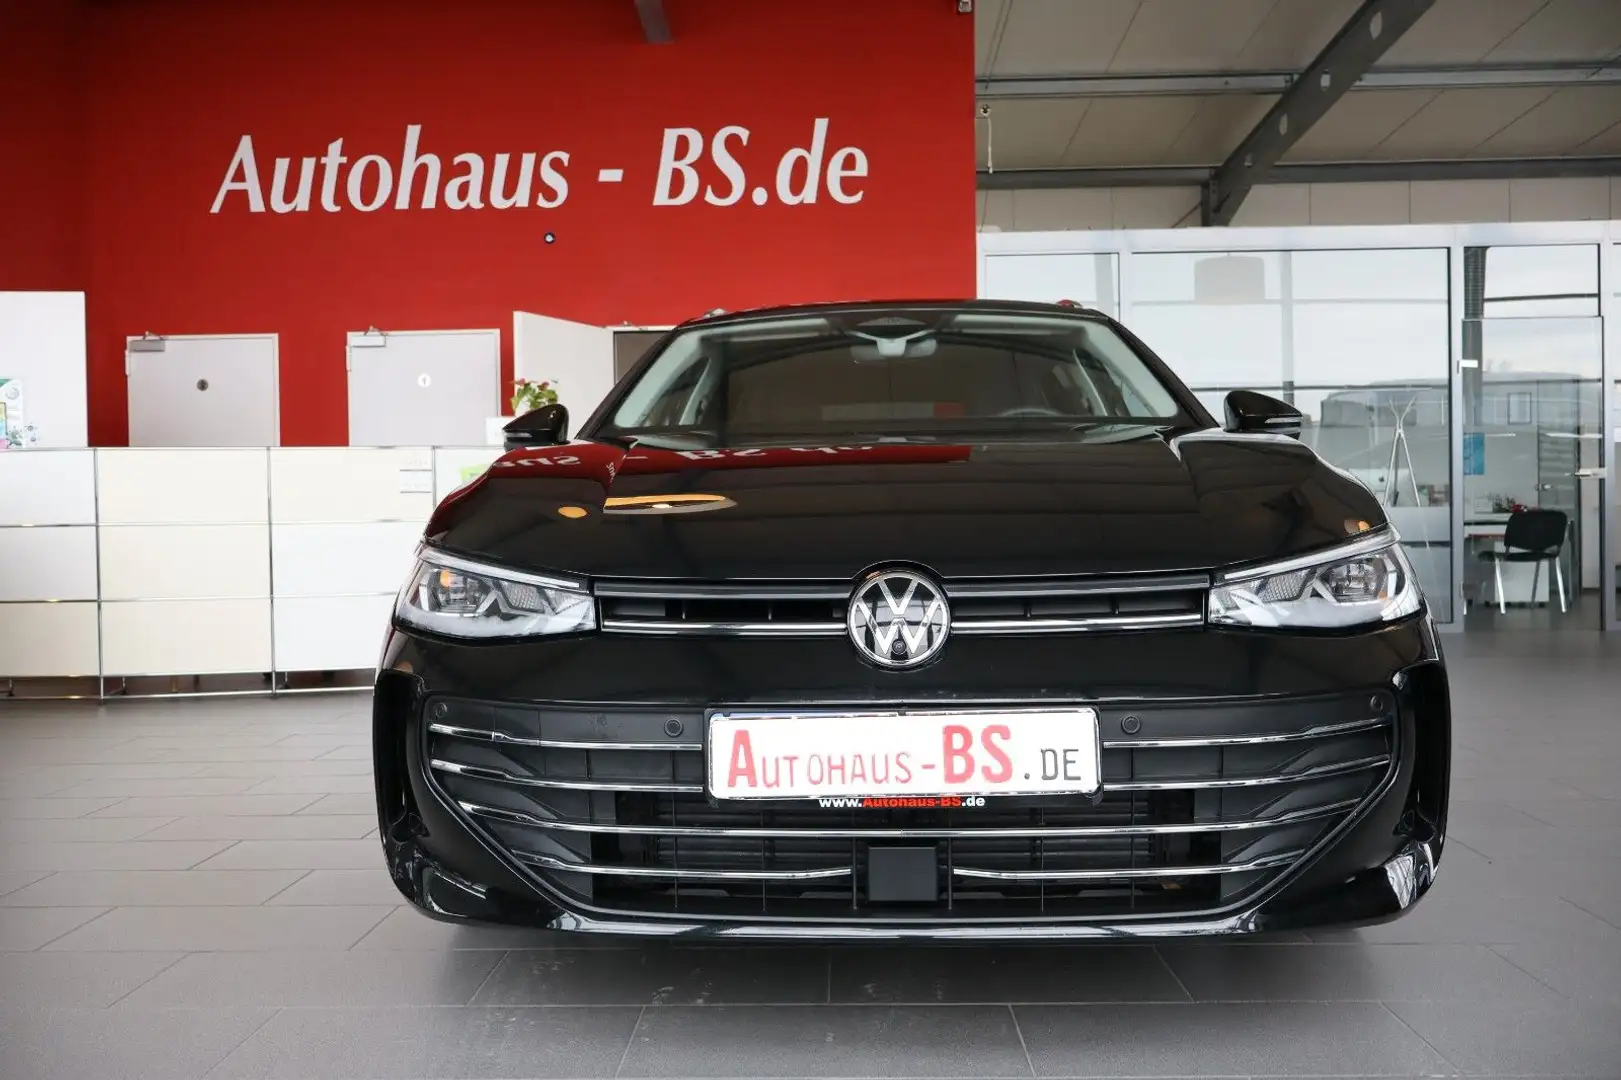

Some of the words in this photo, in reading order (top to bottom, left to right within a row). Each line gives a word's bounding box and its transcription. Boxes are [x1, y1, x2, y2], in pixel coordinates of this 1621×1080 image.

[209, 124, 570, 213] Autohaus
[598, 168, 624, 182] -
[652, 117, 868, 207] BS.de
[818, 796, 986, 808] www.Autohaus-BS.de
